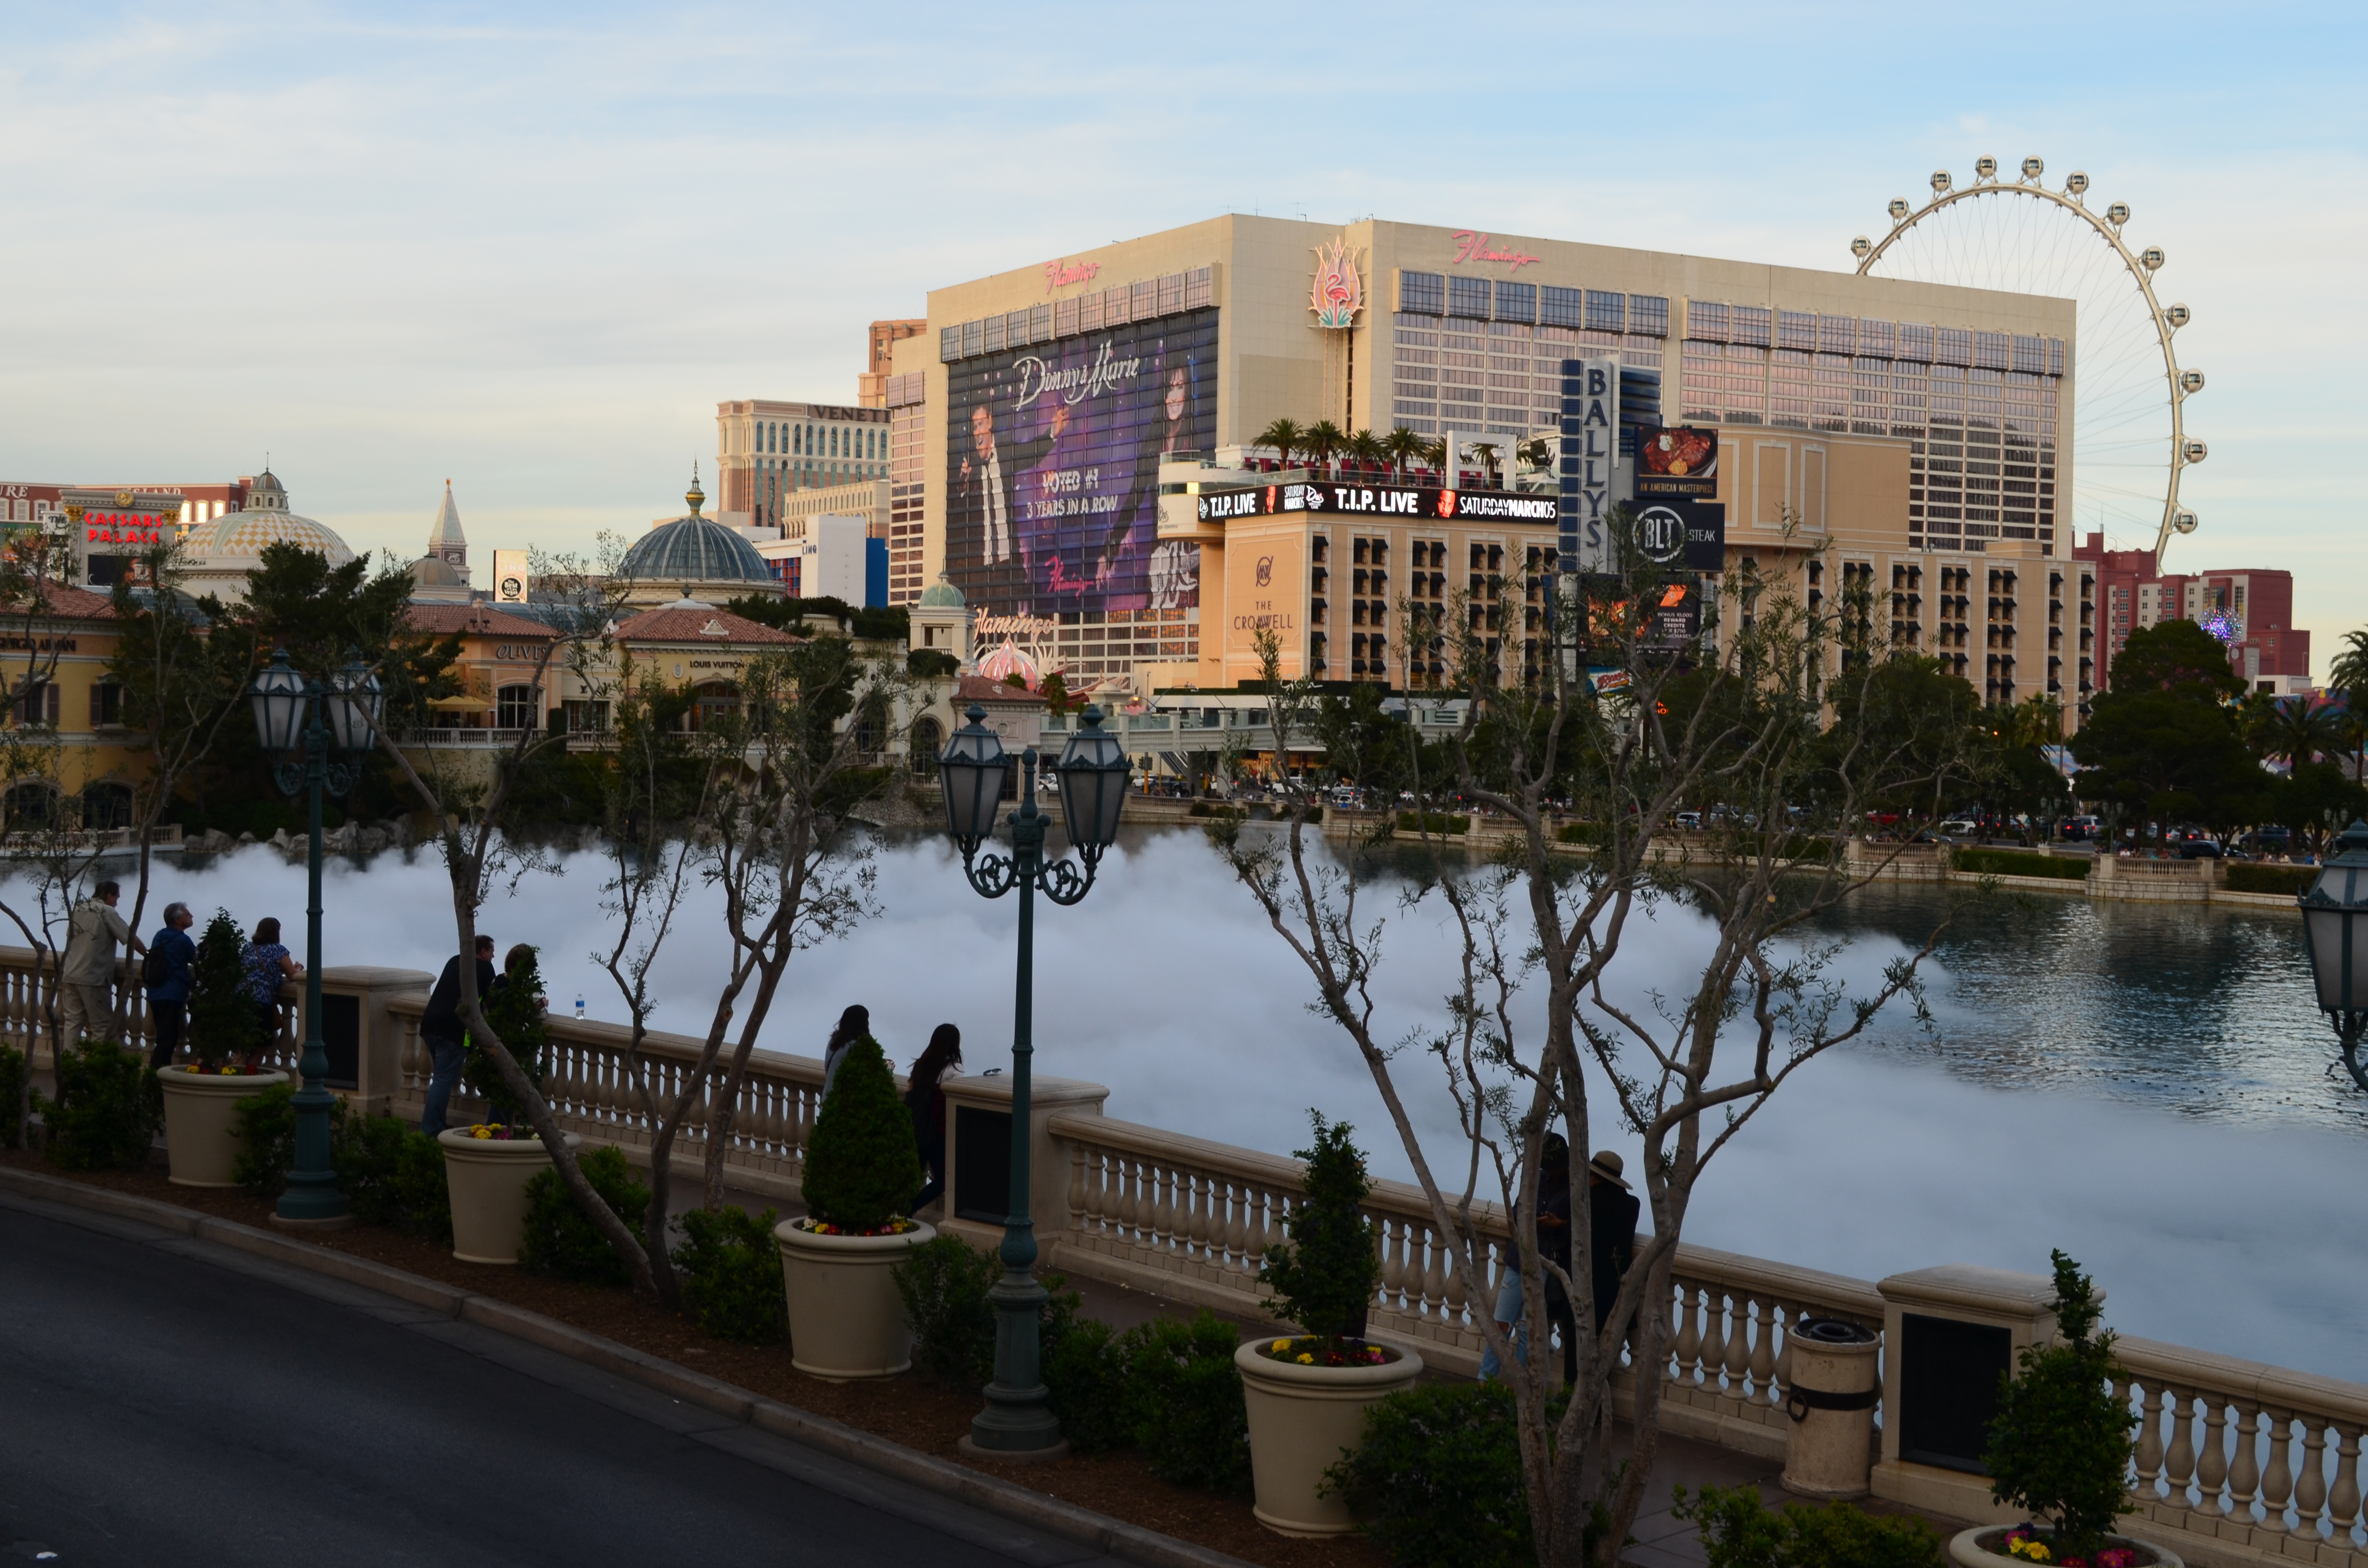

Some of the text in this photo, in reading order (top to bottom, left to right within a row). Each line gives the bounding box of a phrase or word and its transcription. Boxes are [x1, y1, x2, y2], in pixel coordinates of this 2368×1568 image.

[1451, 230, 1541, 272] Flamingo
[1045, 258, 1101, 295] Flamingo
[1011, 356, 1080, 411] Donny
[1042, 468, 1098, 494] VOTED #1
[1284, 484, 1305, 498] SATURDAY
[1640, 483, 1714, 493] AN AMERICAN MASTERPIECE
[1027, 495, 1118, 519] 3 YEARS IN A ROW
[1210, 493, 1256, 517] T.I.P. LIVE
[1335, 489, 1418, 513] T.I.P. LIVE
[84, 512, 163, 528] CAESARS
[88, 529, 159, 544] PALACE
[1645, 518, 1674, 549] BLT
[1689, 529, 1715, 542] STEAK
[802, 544, 817, 555] LINQ
[1045, 556, 1095, 600] Flamingo
[1256, 601, 1271, 610] THE
[1234, 614, 1293, 630] CROMWELL
